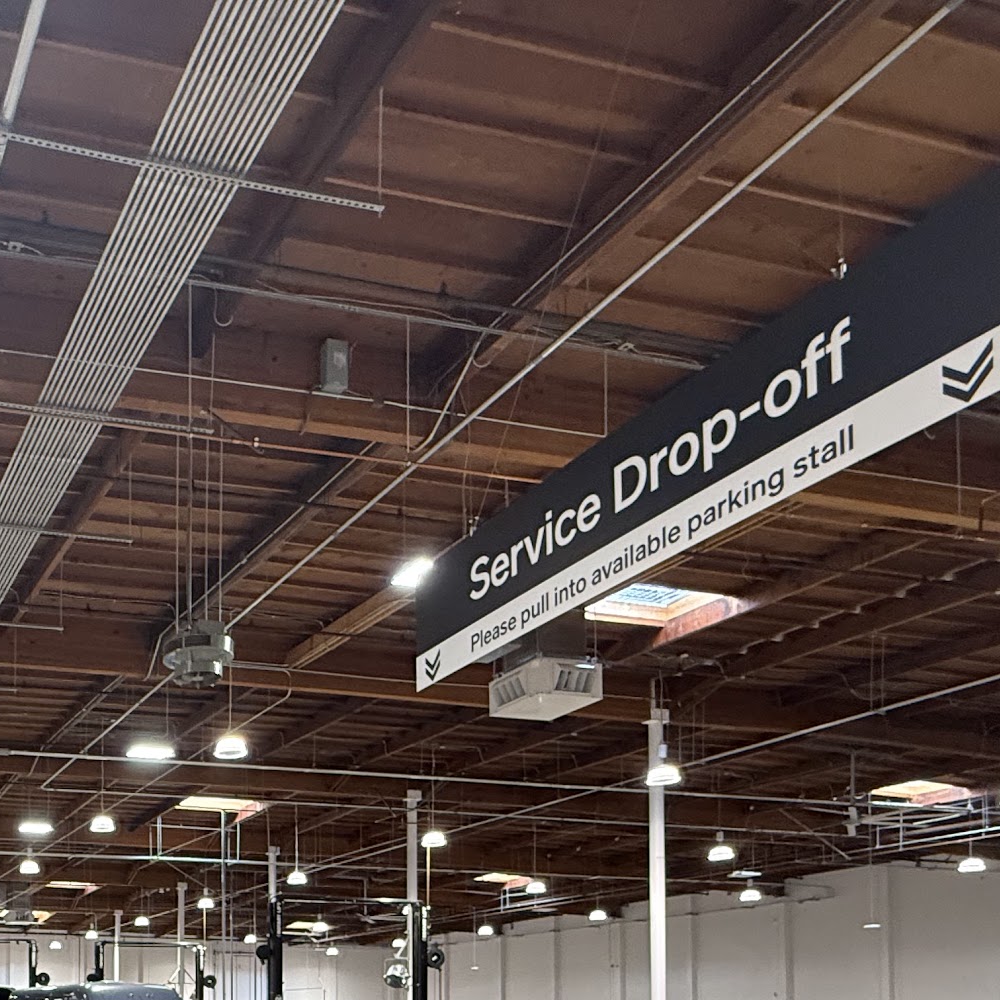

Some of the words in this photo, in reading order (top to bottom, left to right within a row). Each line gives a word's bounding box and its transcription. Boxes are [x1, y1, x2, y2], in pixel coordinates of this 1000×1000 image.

[469, 493, 601, 601] Service
[613, 315, 851, 514] Drop-off
[470, 615, 517, 653] Please
[520, 594, 550, 630] pull
[553, 577, 587, 607] into
[591, 526, 681, 586] available
[687, 466, 785, 540] parking
[793, 424, 854, 479] stall
